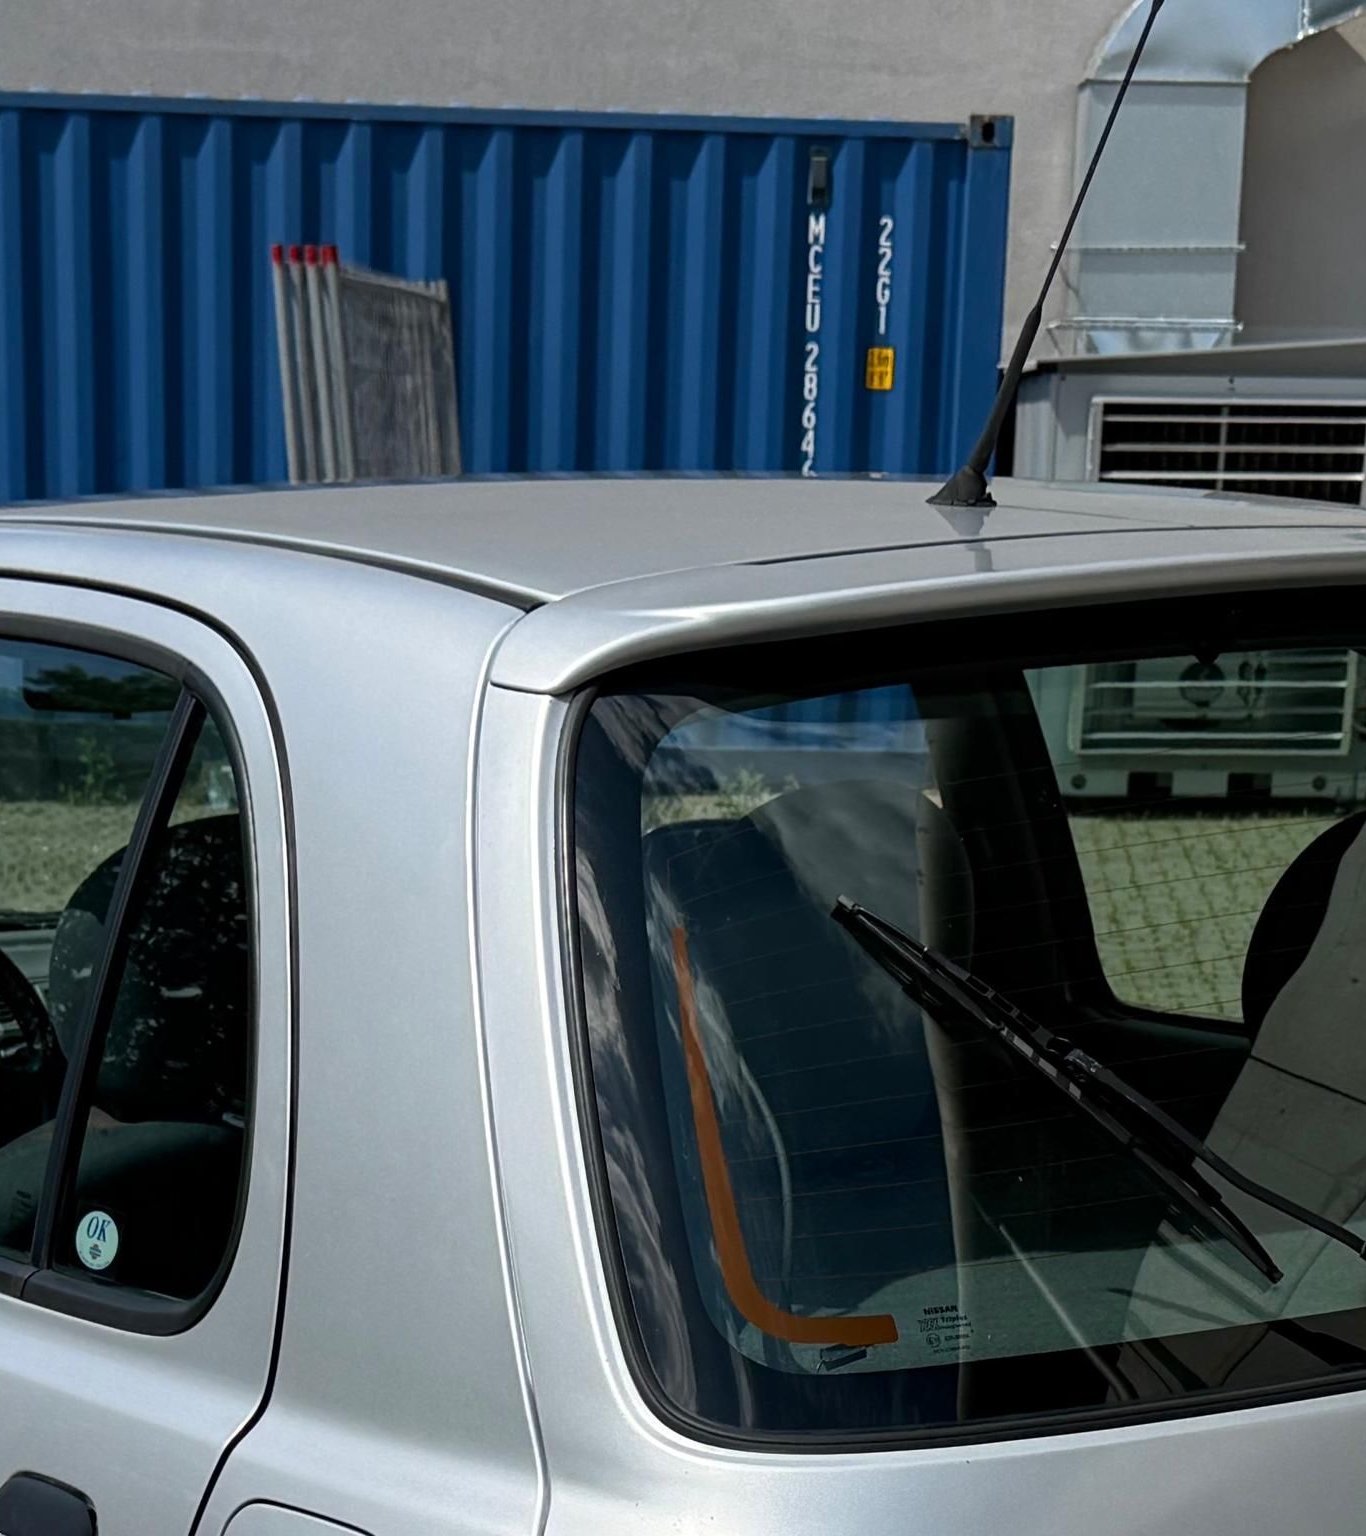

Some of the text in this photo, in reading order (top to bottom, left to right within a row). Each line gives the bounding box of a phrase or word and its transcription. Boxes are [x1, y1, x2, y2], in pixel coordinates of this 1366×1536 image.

[805, 212, 826, 333] MCEU
[875, 215, 893, 334] 22G1
[87, 1216, 111, 1242] OK
